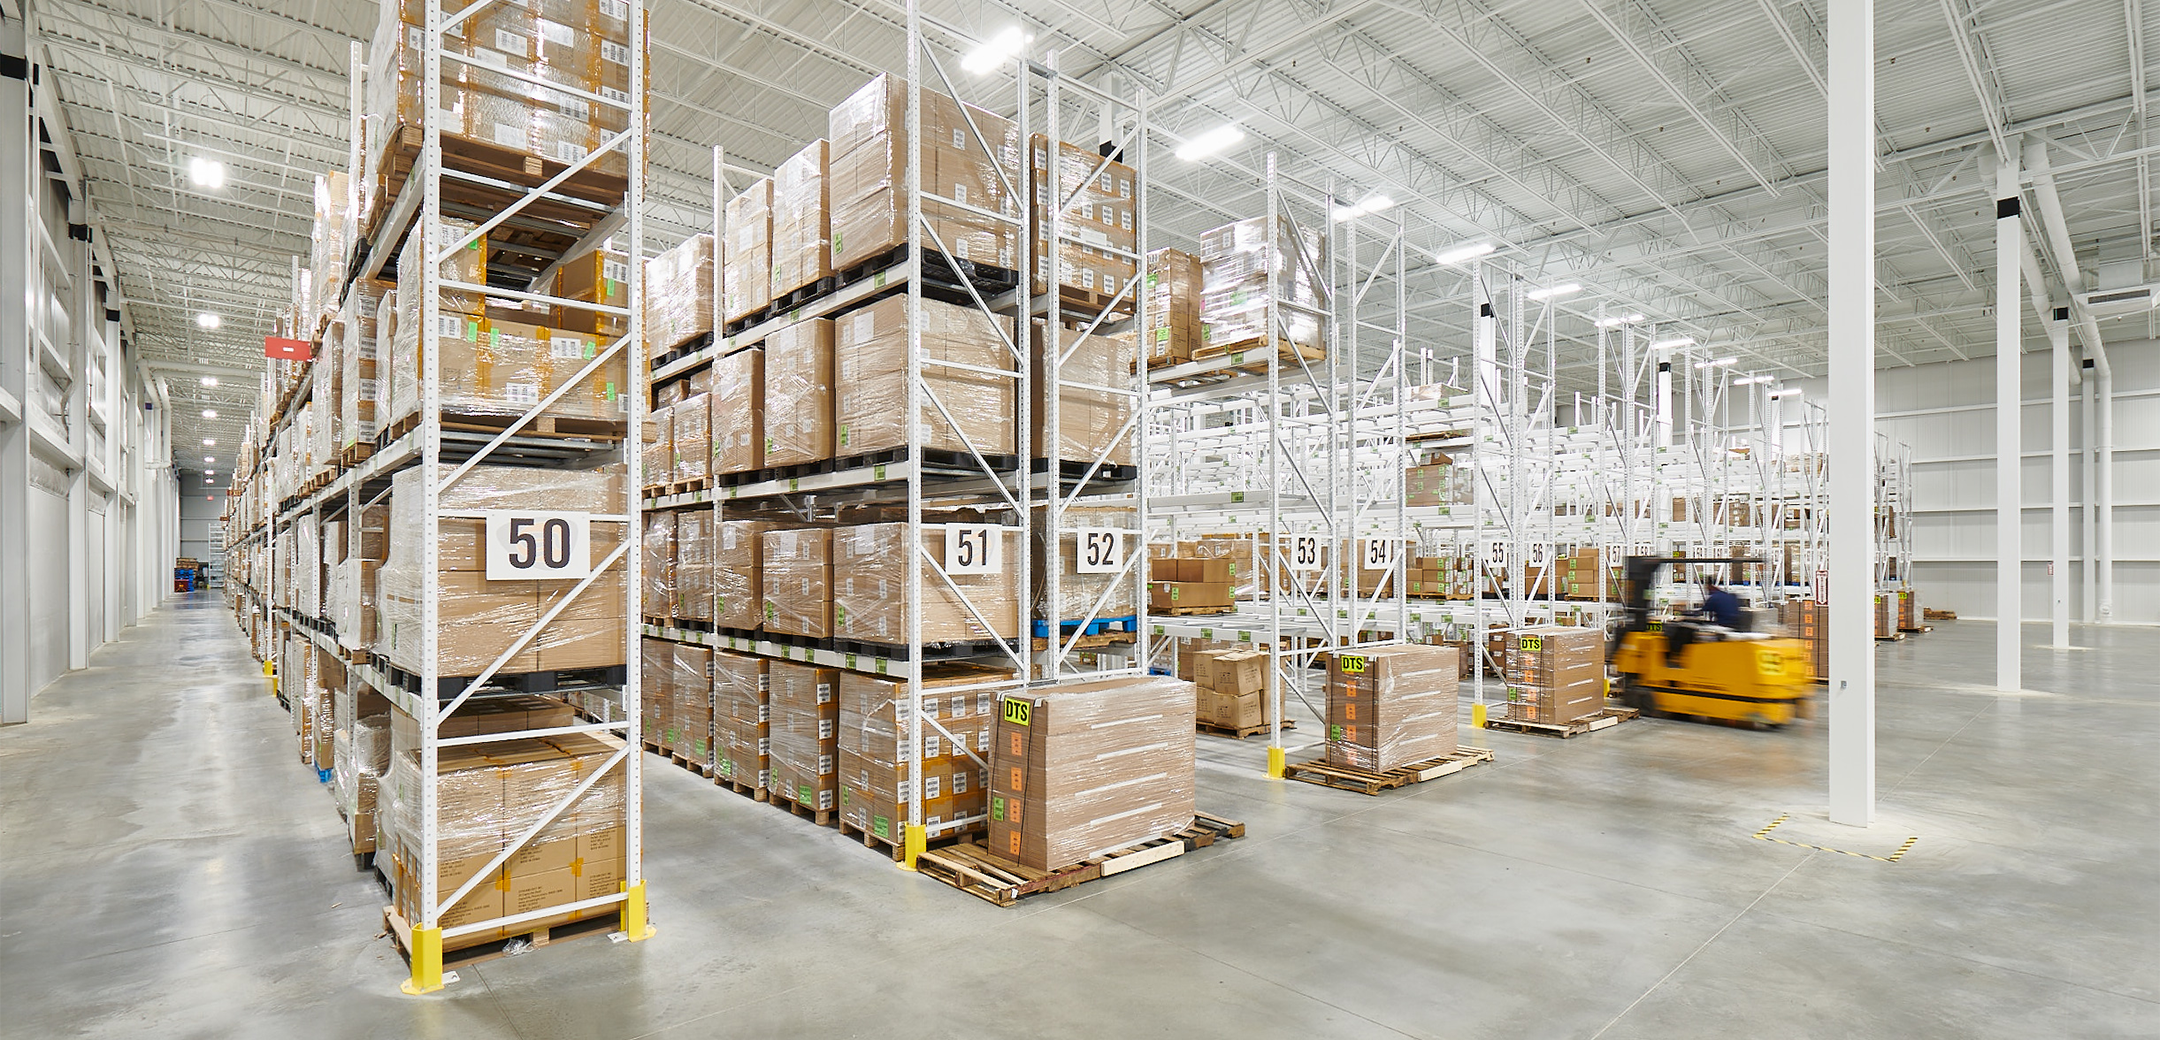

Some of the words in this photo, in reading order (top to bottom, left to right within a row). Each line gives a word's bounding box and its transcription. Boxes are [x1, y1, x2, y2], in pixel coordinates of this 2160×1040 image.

[508, 518, 570, 569] 50
[957, 529, 987, 566] 51
[1087, 532, 1115, 566] 52
[1297, 537, 1316, 565] 53
[1370, 539, 1386, 564] 54
[1492, 542, 1504, 563] 55
[1532, 543, 1543, 563] 56
[1521, 637, 1541, 649] DTS
[1341, 657, 1364, 672] DTS
[1005, 699, 1028, 722] DTS
